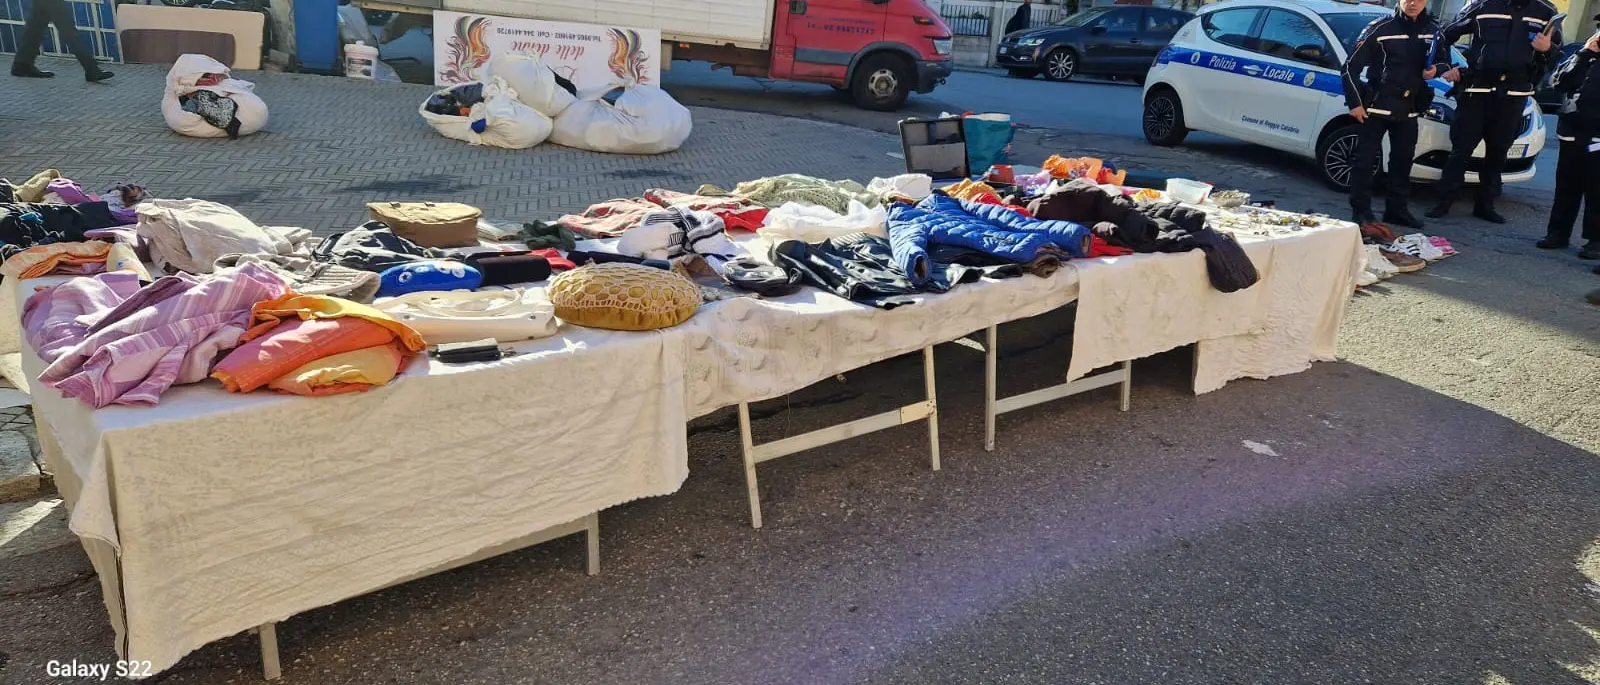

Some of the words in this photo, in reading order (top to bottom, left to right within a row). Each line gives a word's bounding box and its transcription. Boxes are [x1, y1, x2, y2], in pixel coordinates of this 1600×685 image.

[556, 45, 585, 60] delle
[1209, 55, 1236, 70] Polizia
[1263, 66, 1295, 81] Locale
